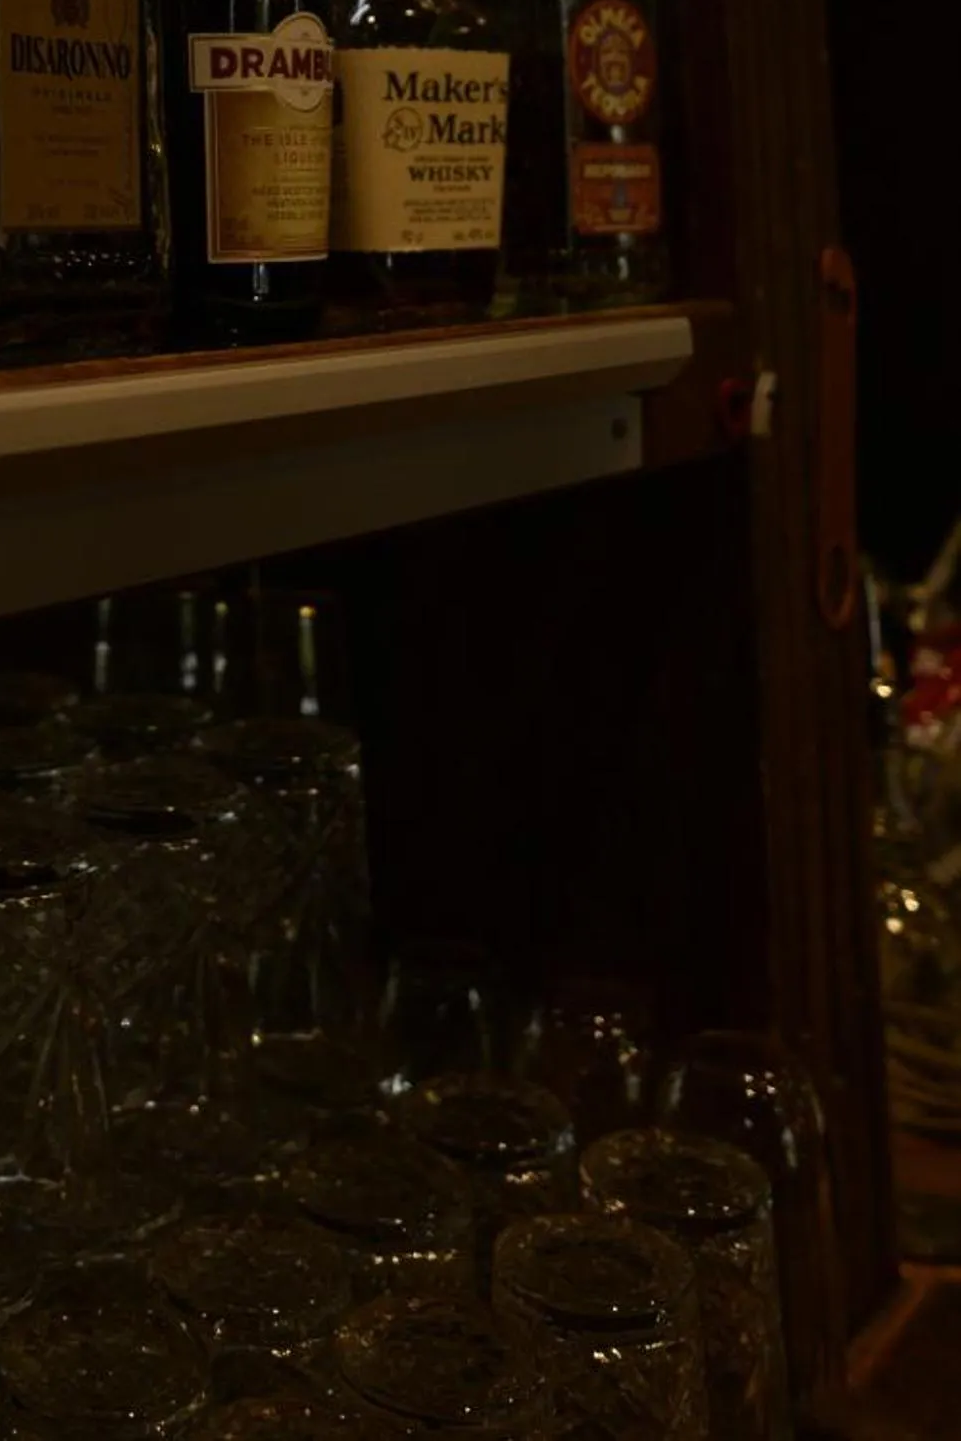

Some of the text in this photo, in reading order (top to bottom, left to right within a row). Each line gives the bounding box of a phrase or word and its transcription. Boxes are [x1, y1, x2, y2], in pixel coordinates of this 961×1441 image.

[11, 32, 132, 82] DISARONNO
[383, 70, 509, 104] Maker's
[420, 113, 508, 146] Mark
[407, 164, 493, 183] WHISKY
